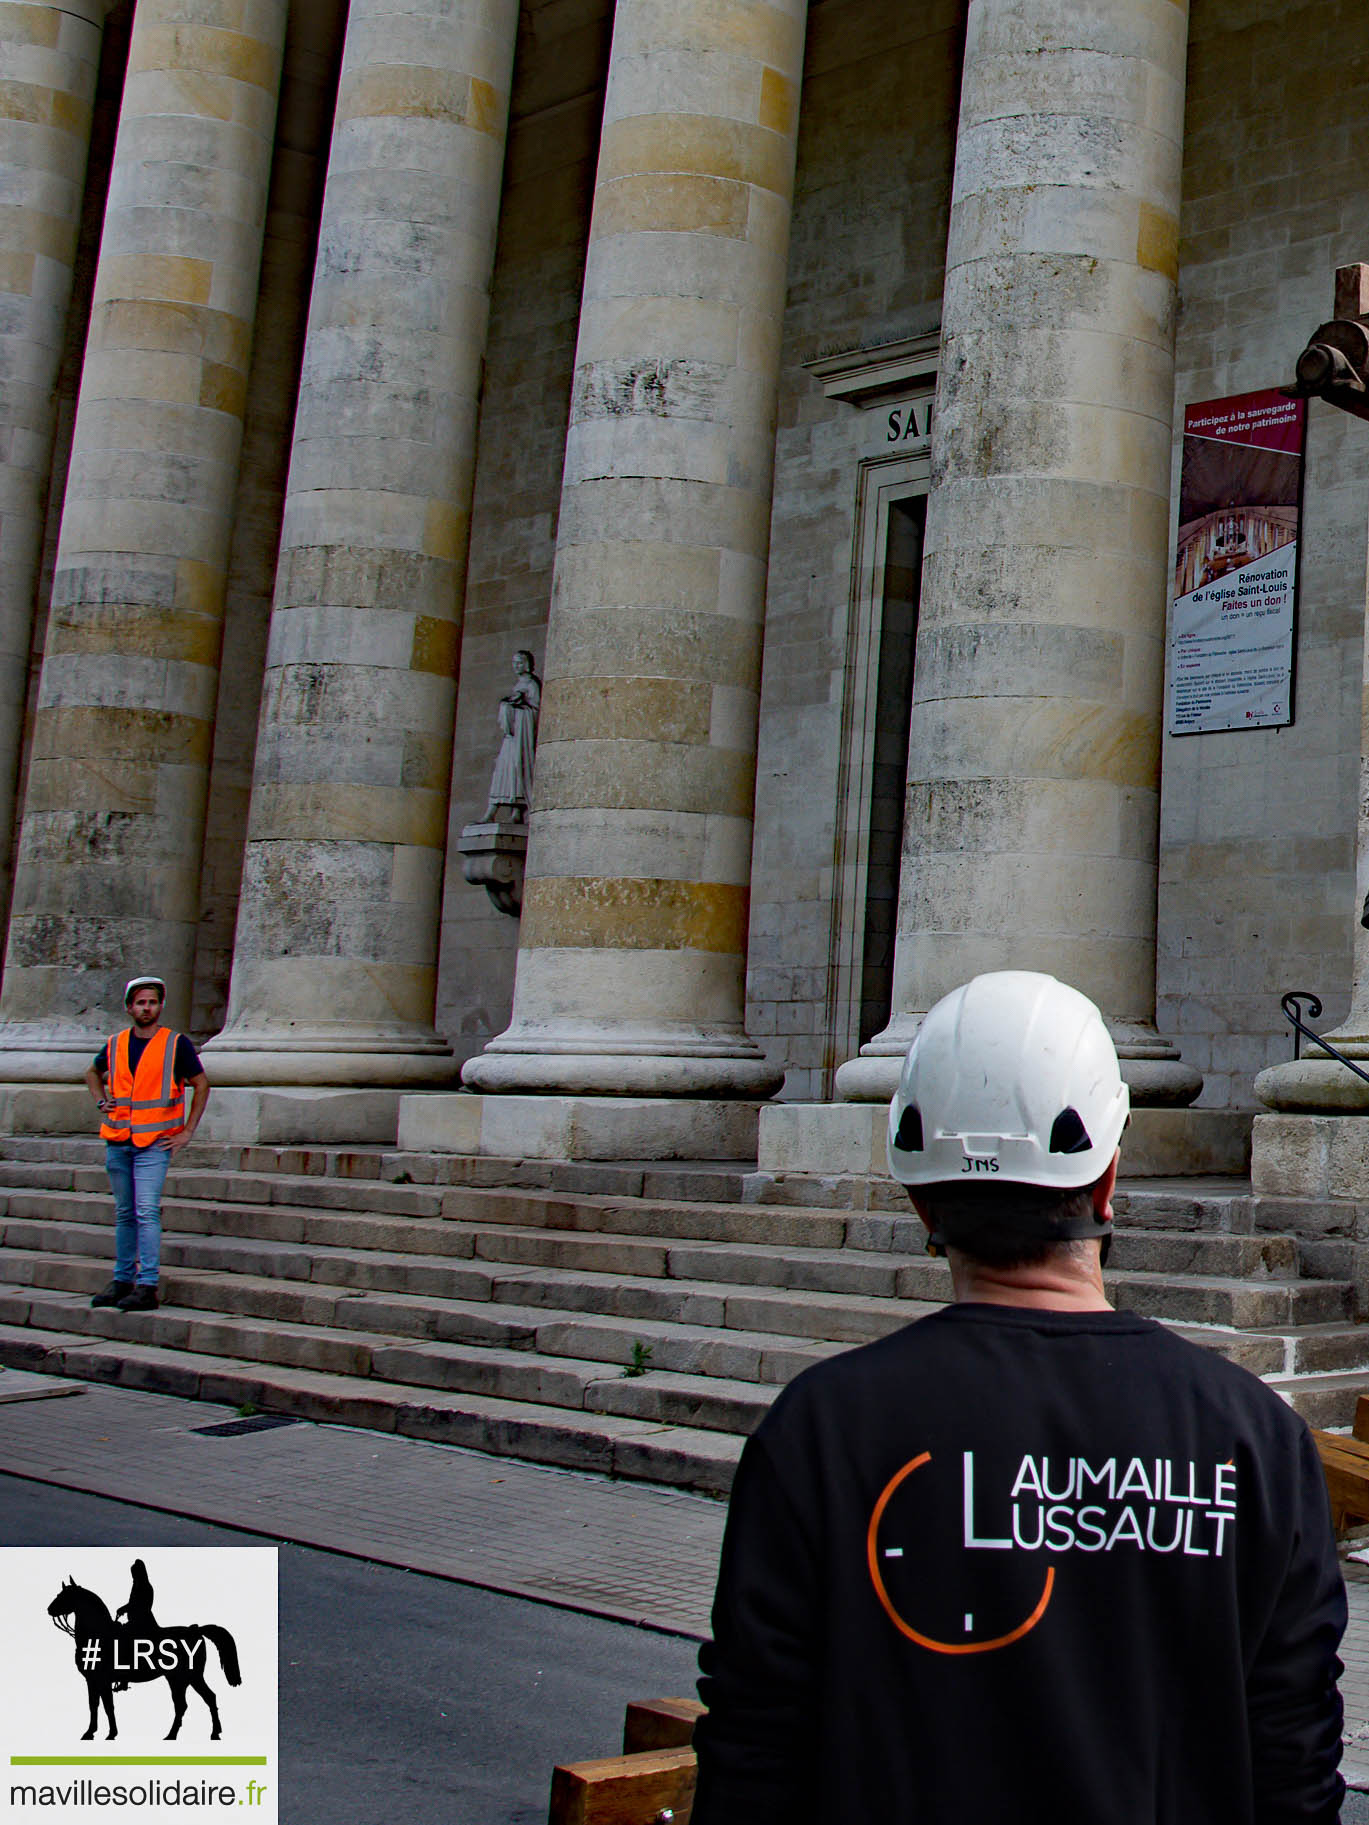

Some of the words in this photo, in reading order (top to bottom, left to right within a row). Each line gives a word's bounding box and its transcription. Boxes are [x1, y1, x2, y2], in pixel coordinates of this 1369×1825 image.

[1187, 415, 1229, 429] Participez
[1230, 411, 1236, 421] à
[1237, 411, 1246, 420] la
[1247, 401, 1296, 418] sauvegarde
[1215, 426, 1226, 435] de
[1228, 422, 1250, 433] notre
[1252, 414, 1297, 430] patrimoine
[1239, 569, 1288, 584] Rénovation
[1192, 593, 1203, 602] de
[1205, 589, 1236, 602] l'église
[1237, 582, 1288, 597] Saint-Louis
[1222, 600, 1248, 611] Faites
[1250, 599, 1262, 608] un
[1265, 596, 1281, 606] don
[961, 1156, 1000, 1173] JMS
